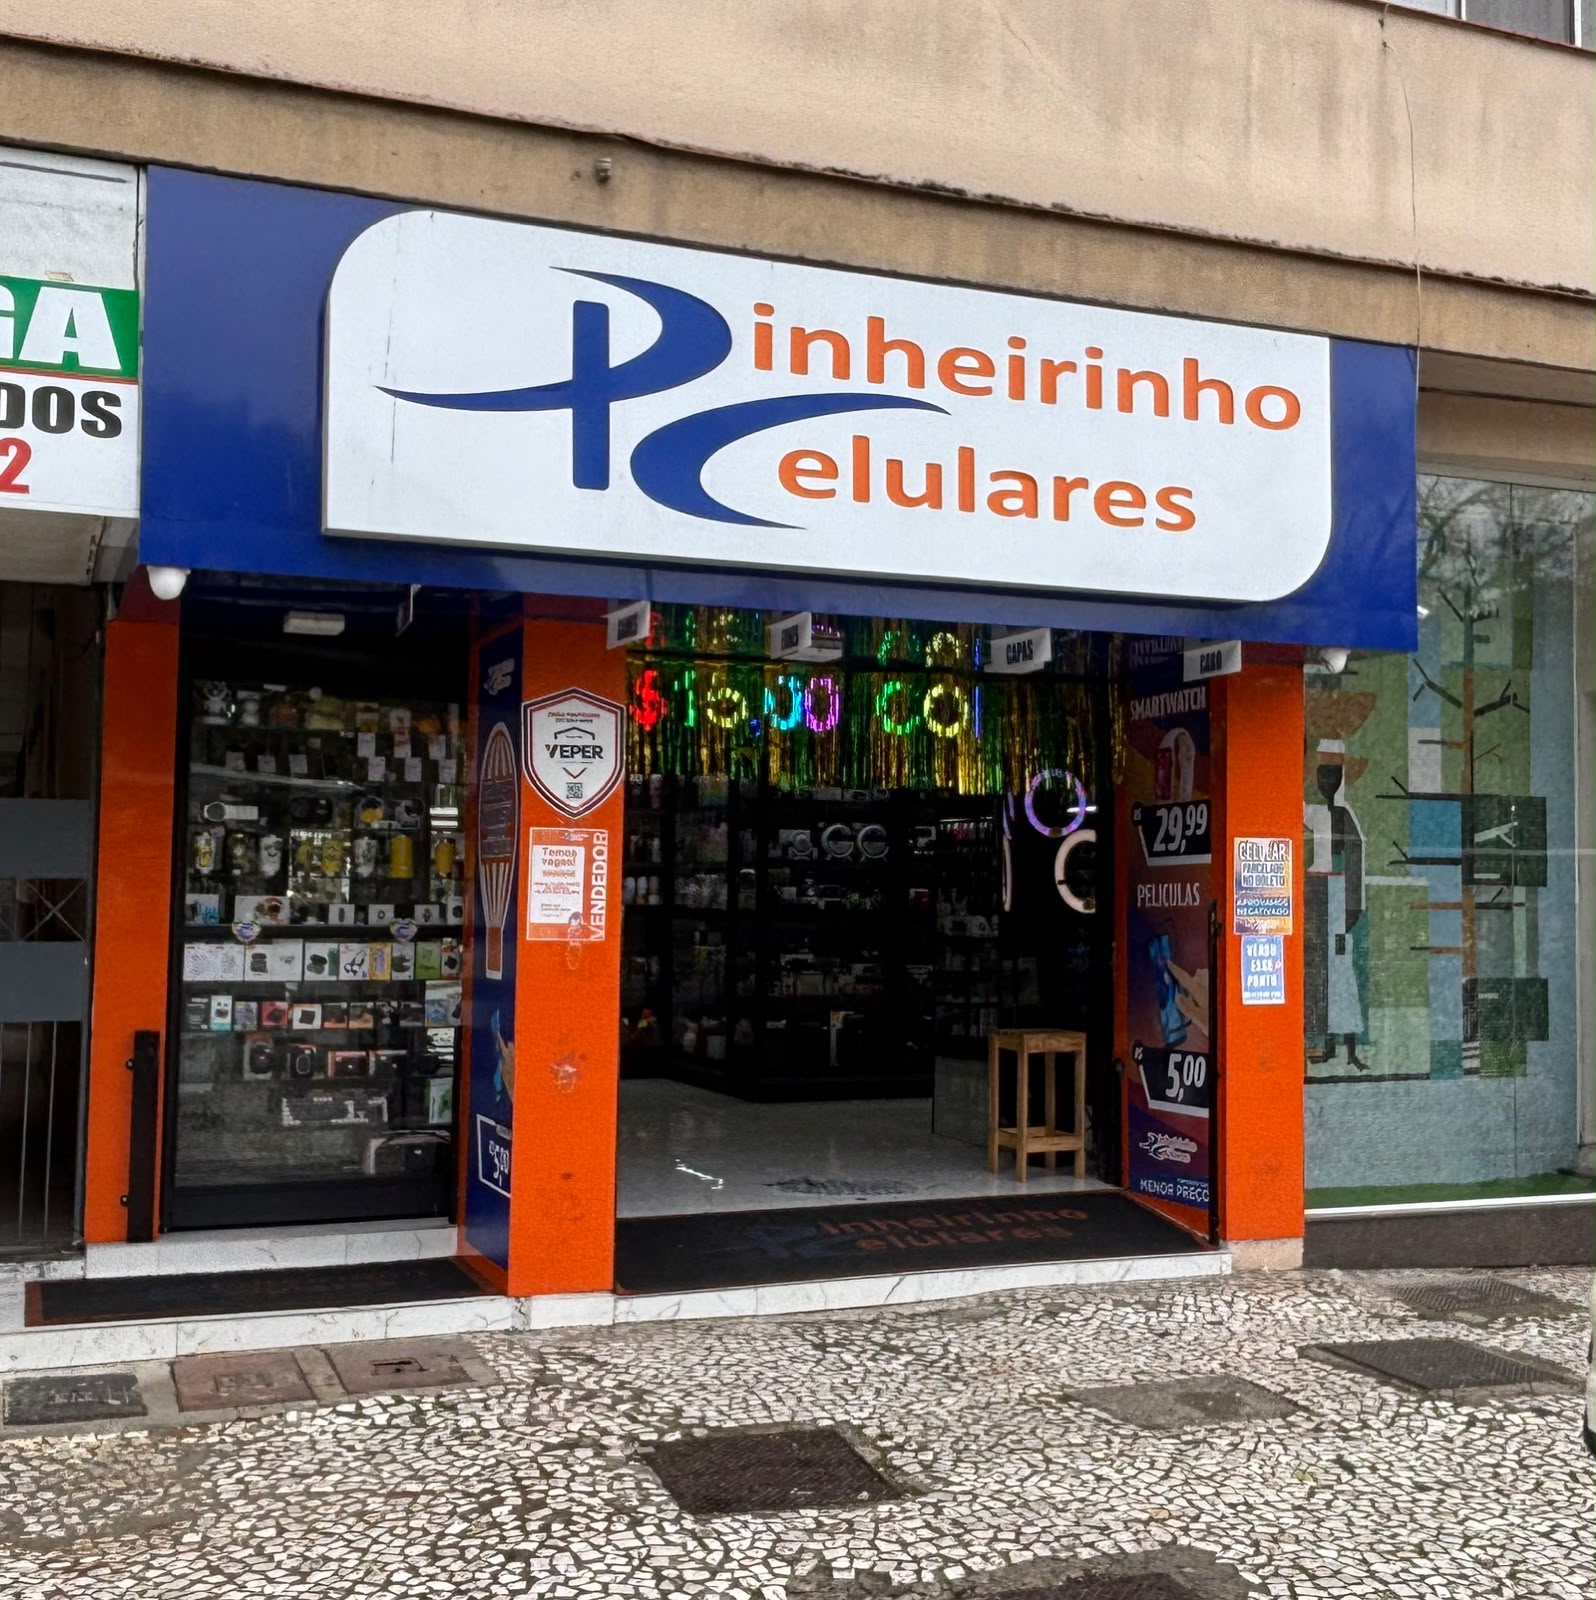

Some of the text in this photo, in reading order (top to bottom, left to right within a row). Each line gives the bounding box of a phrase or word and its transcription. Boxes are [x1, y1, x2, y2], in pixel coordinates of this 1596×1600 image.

[0, 280, 121, 370] A
[1130, 685, 1206, 721] SMARTWATCH
[545, 744, 603, 759] VEPER
[1153, 804, 1208, 854] 29,99
[590, 831, 608, 940] VENDEDOR
[1165, 1053, 1207, 1103] 5,00
[1139, 1178, 1174, 1198] MENOR
